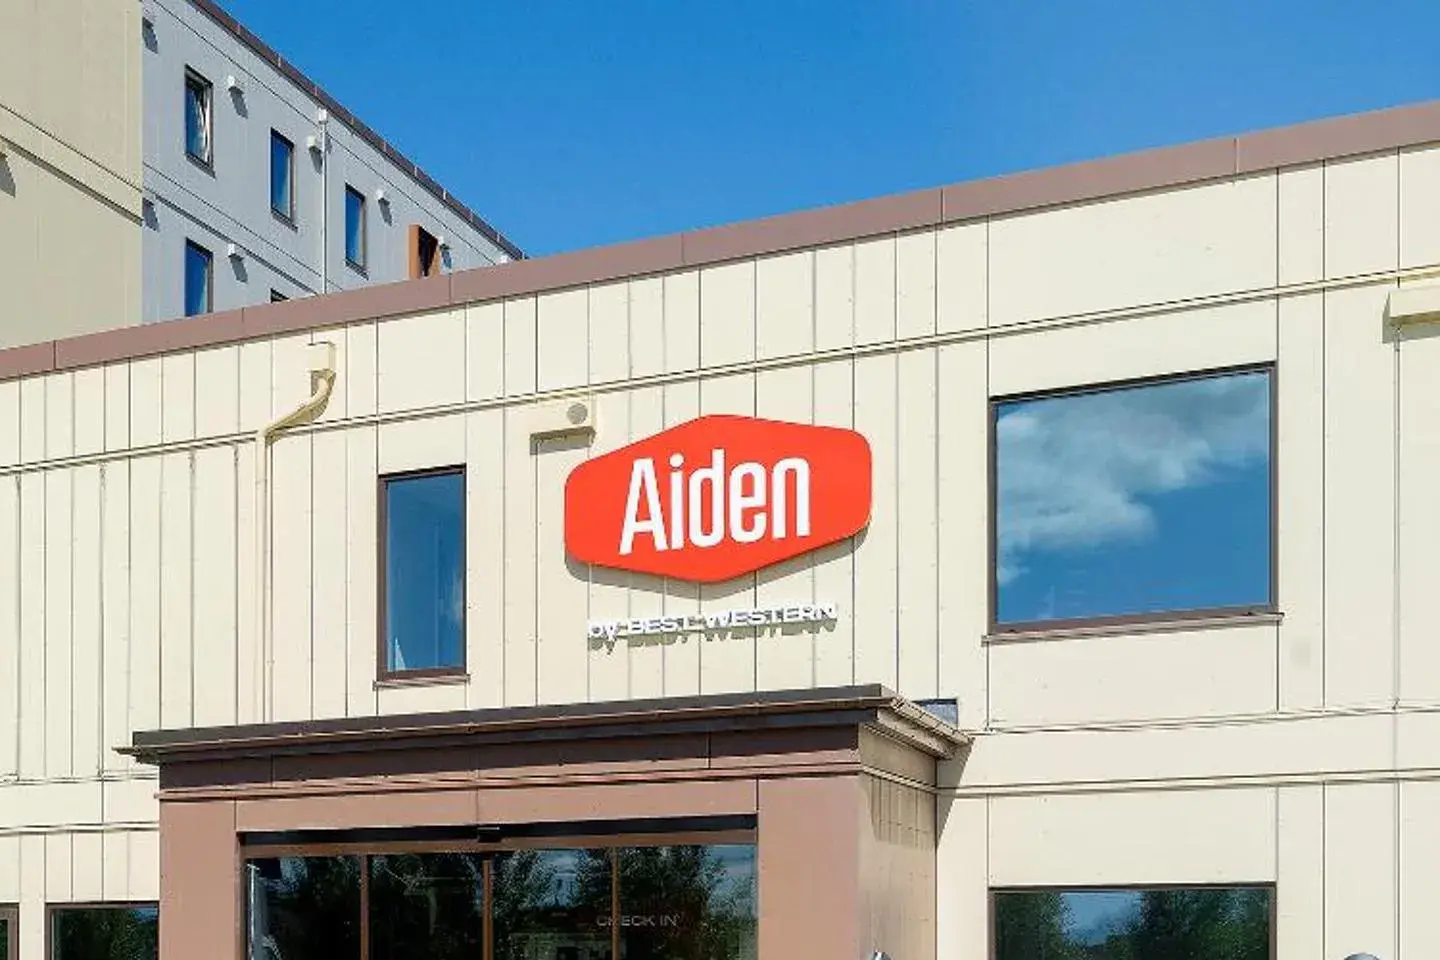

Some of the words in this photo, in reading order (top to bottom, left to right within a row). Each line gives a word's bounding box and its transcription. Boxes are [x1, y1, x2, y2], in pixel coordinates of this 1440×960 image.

[618, 448, 811, 555] Aiden
[627, 612, 696, 635] BEST
[702, 602, 838, 630] WESTERN
